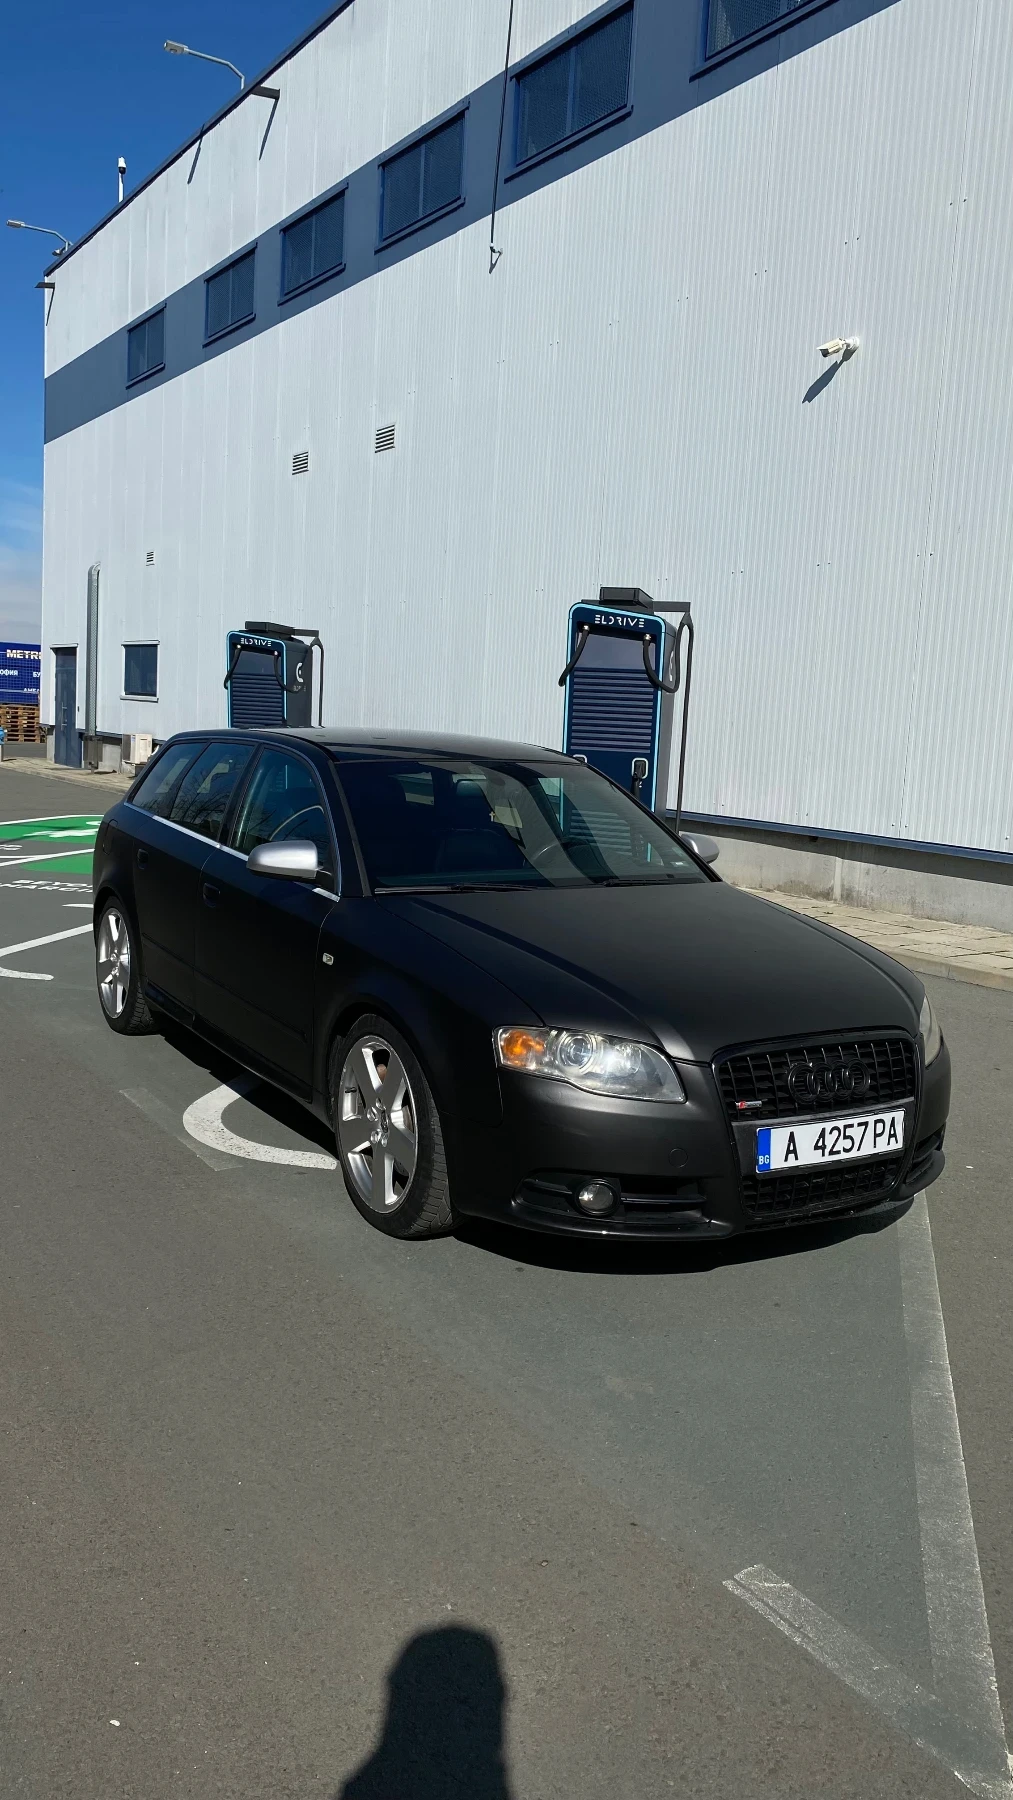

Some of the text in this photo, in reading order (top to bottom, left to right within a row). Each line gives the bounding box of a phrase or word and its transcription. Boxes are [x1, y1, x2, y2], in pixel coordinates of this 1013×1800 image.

[594, 614, 645, 628] ELDRIVE
[240, 637, 272, 647] ELDRIVE
[758, 1154, 770, 1165] BG
[783, 1130, 799, 1163] A
